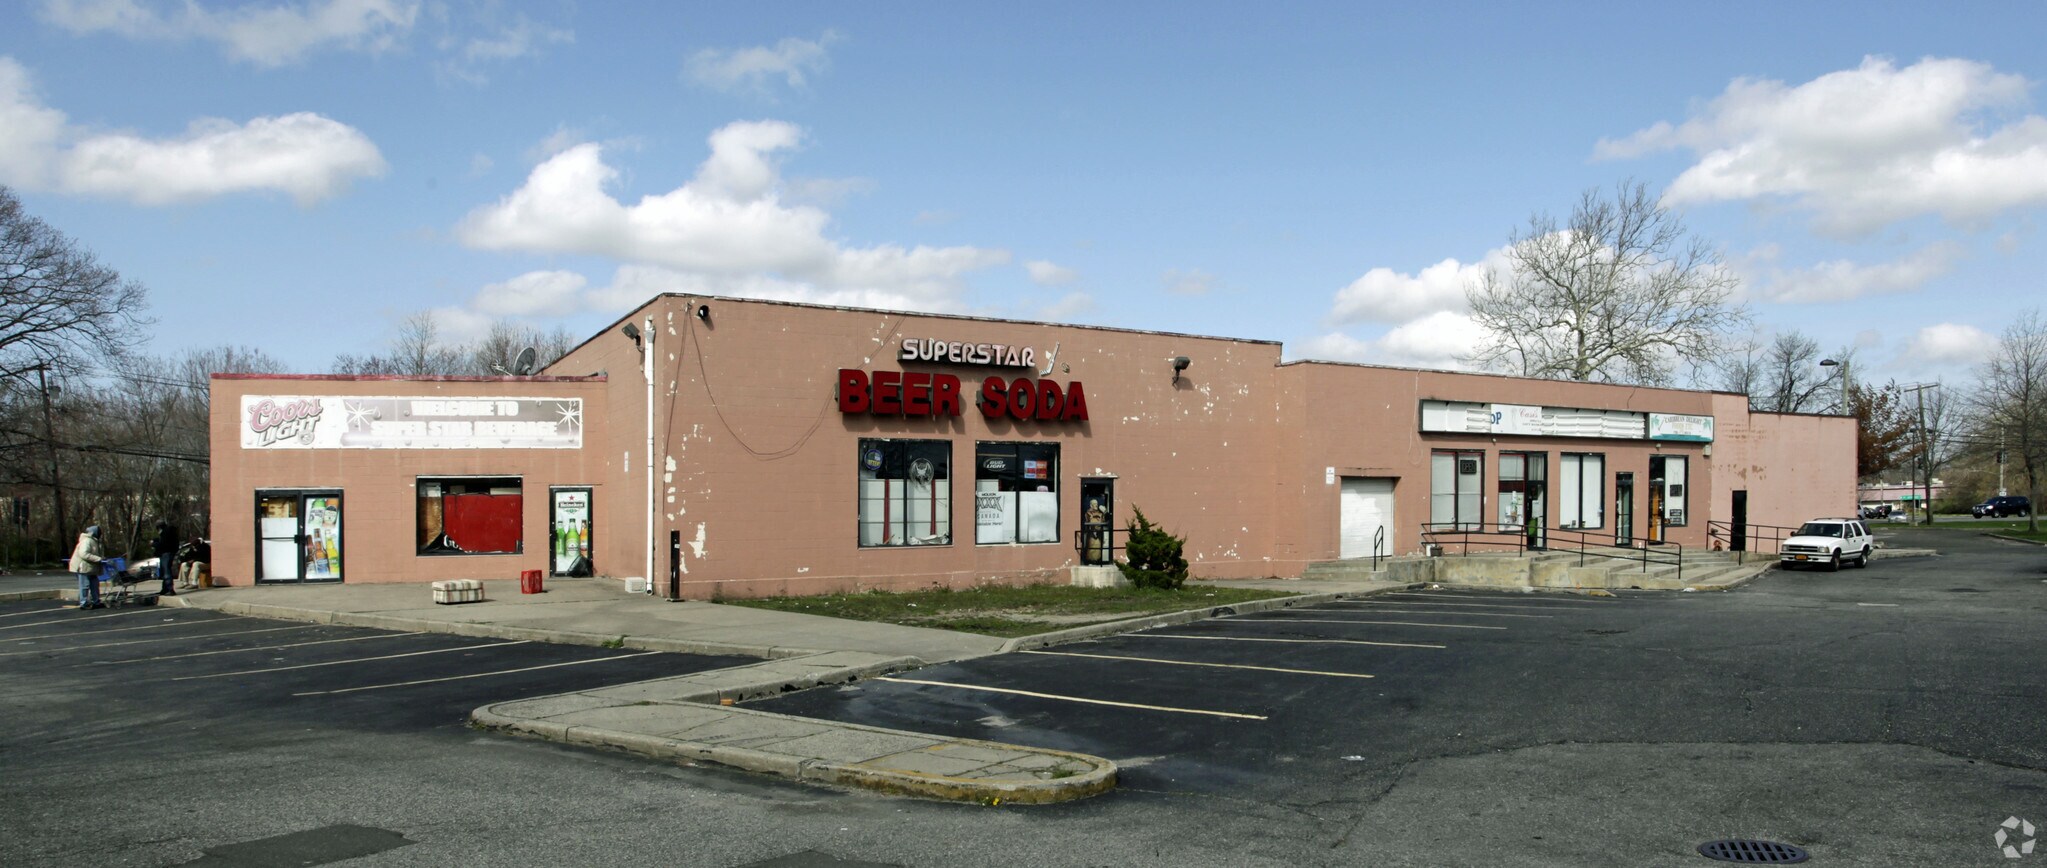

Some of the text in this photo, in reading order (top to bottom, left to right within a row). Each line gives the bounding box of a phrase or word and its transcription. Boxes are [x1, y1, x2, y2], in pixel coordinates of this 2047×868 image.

[902, 339, 1035, 367] SUPERSTAR
[411, 400, 519, 416] WELCOME TO
[838, 369, 1089, 420] BEER SODA
[248, 399, 323, 432] Coors
[370, 421, 557, 436] SUPER STAR BEVERAGE
[258, 416, 320, 446] LIGHT
